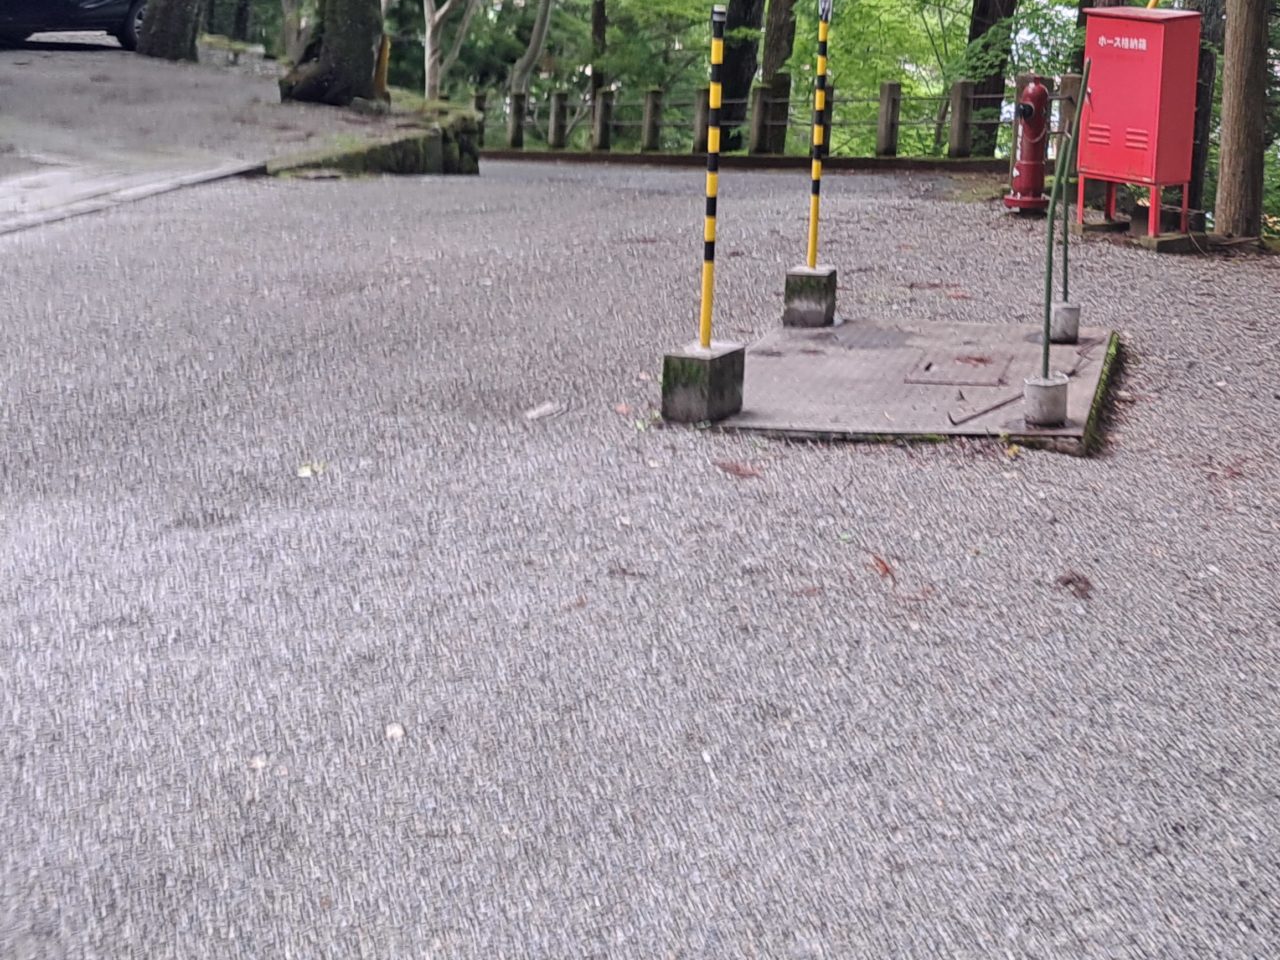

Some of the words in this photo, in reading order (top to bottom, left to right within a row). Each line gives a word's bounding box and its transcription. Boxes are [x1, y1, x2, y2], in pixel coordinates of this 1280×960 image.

[1098, 36, 1147, 50] ホース格納箱
